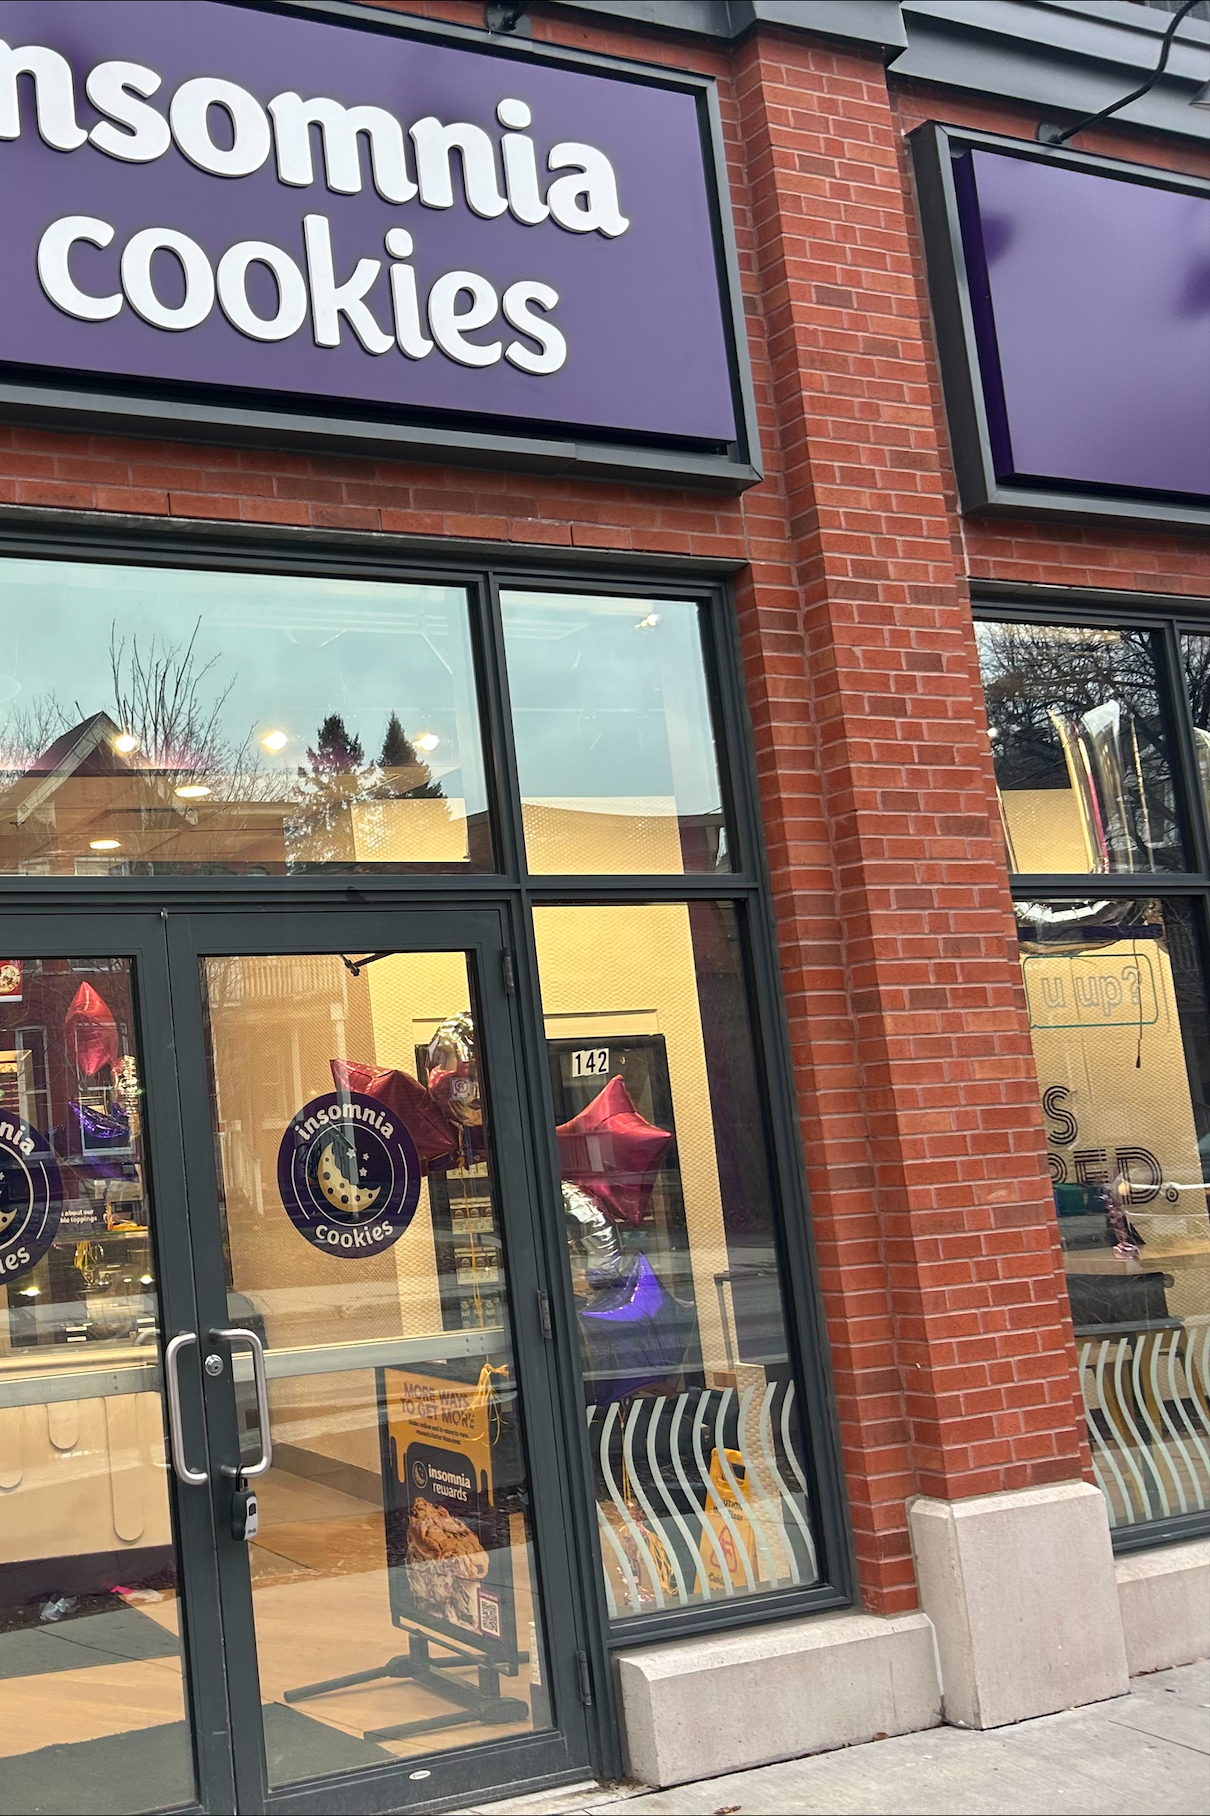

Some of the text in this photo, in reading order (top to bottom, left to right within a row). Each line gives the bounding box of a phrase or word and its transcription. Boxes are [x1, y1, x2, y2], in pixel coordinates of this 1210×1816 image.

[37, 214, 568, 376] cookies
[1041, 964, 1143, 1017] u up?
[574, 1050, 608, 1075] 142
[294, 1101, 395, 1141] insomnia
[1042, 1085, 1079, 1146] S
[65, 1209, 83, 1217] about
[70, 1216, 98, 1224] toppings
[315, 1218, 394, 1249] cookies
[404, 1382, 470, 1409] MORE WAYS
[400, 1398, 475, 1430] TO GET MORE
[428, 1464, 471, 1489] insomnia
[432, 1481, 468, 1502] rewards
